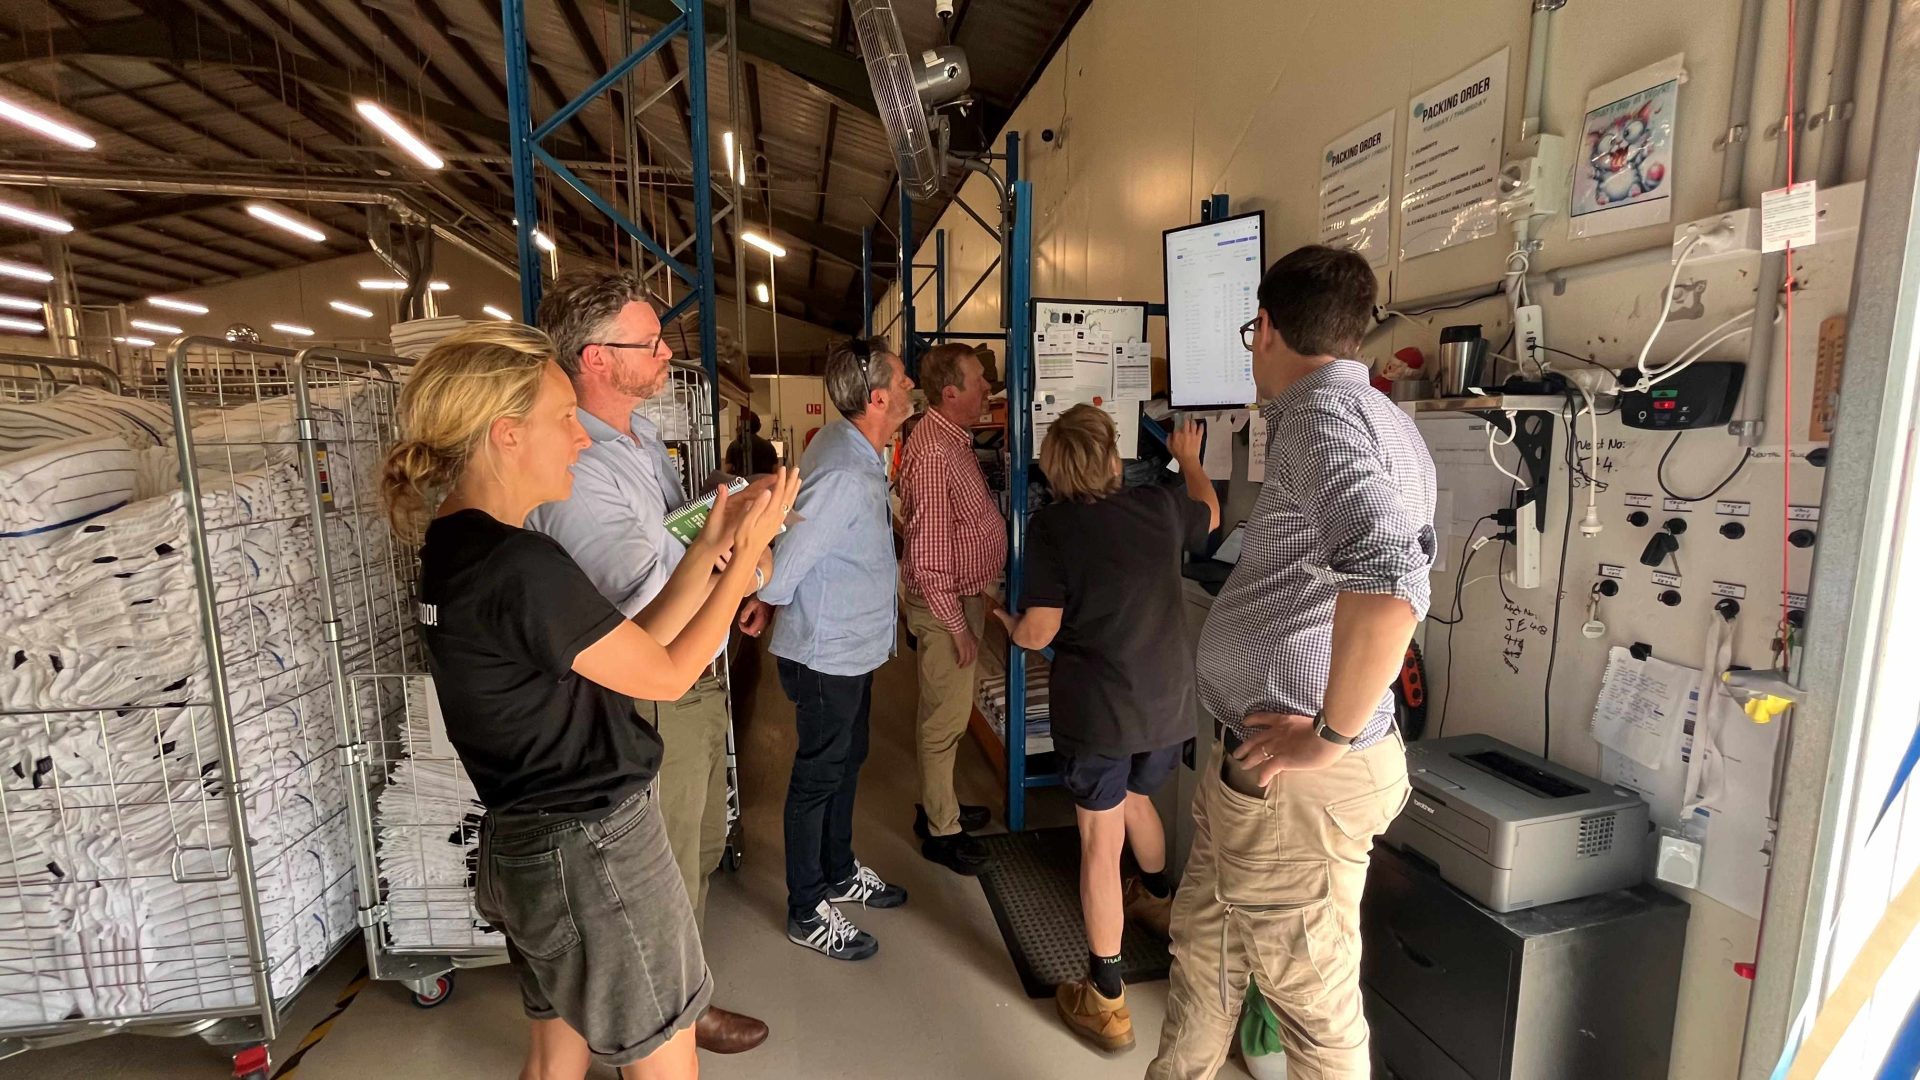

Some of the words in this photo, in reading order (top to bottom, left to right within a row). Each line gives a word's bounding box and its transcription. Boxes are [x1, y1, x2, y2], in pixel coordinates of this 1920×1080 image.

[1422, 93, 1459, 123] PACKING
[1460, 76, 1491, 104] ORDER
[1331, 144, 1359, 168] PACKING
[1360, 132, 1382, 154] ORDER
